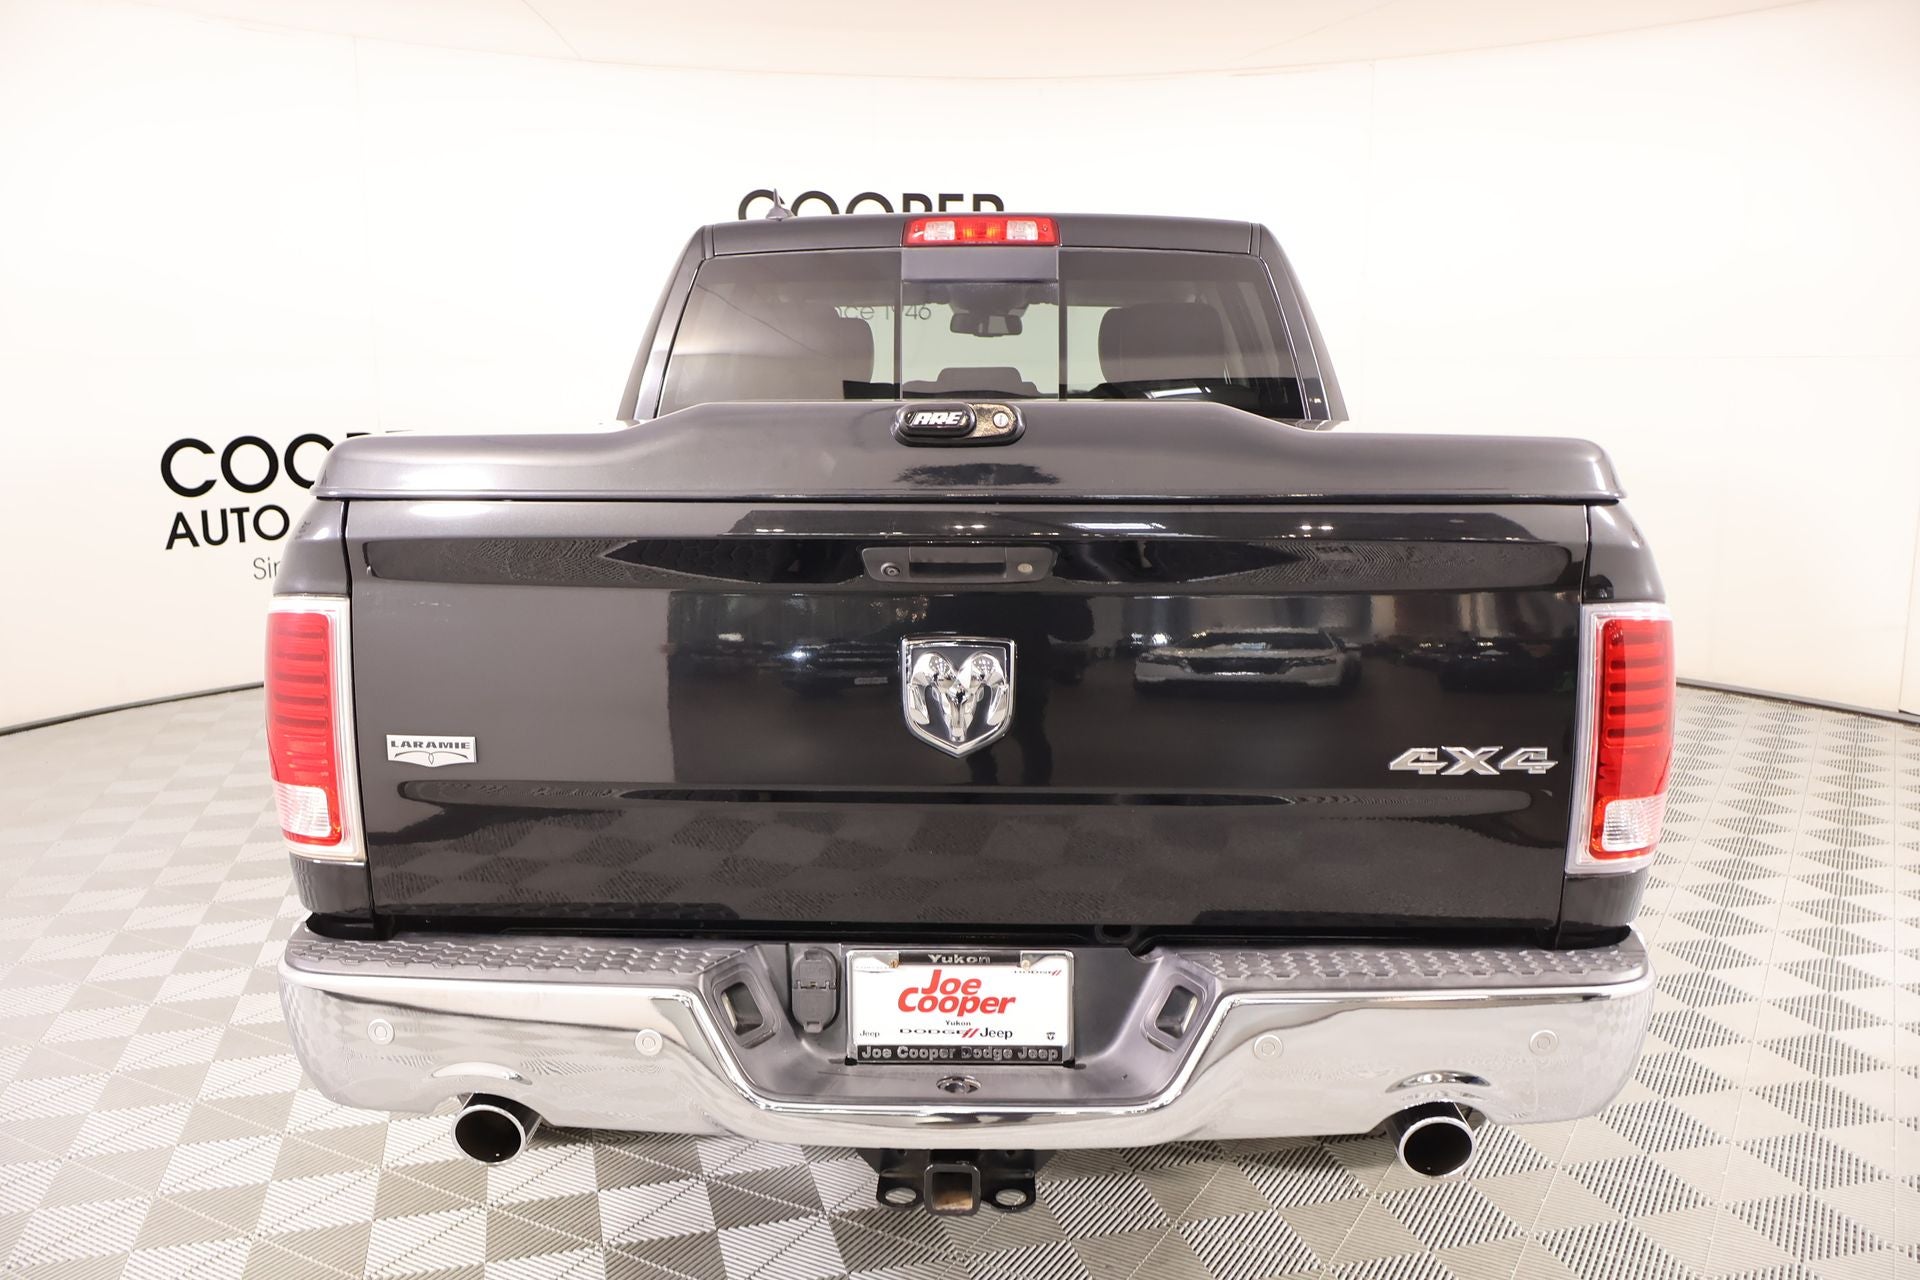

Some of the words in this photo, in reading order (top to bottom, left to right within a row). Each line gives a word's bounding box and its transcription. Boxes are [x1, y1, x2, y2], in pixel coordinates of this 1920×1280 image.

[885, 304, 931, 320] 146
[165, 504, 290, 550] AUTO
[391, 740, 471, 749] LARAMIE
[928, 953, 991, 965] Yukon
[921, 969, 982, 996] Joe
[898, 987, 1016, 1017] Cooper
[980, 1027, 1013, 1040] Jeep
[861, 1046, 892, 1059] Joe
[897, 1046, 955, 1061] Cooper
[961, 1046, 1013, 1061] Dodge
[1018, 1046, 1058, 1061] Jeep
